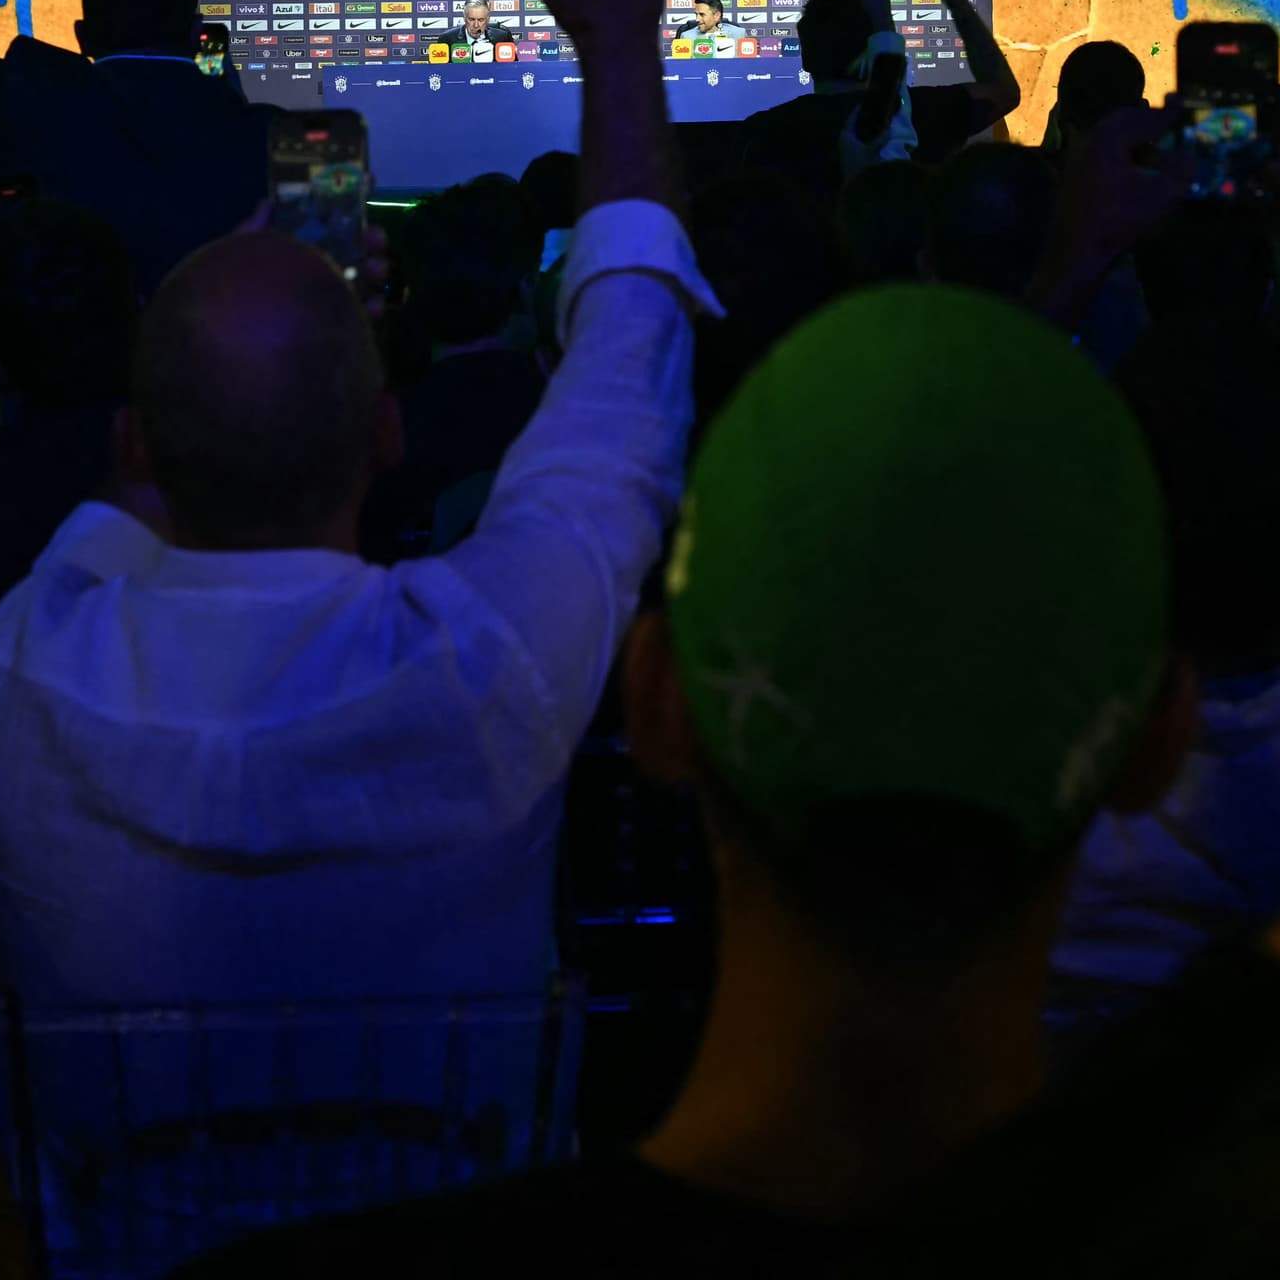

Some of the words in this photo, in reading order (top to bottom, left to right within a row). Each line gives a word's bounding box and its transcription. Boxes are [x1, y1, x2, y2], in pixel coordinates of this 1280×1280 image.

[239, 5, 258, 13] vivo
[275, 5, 293, 13] Azul
[420, 3, 438, 11] vivo
